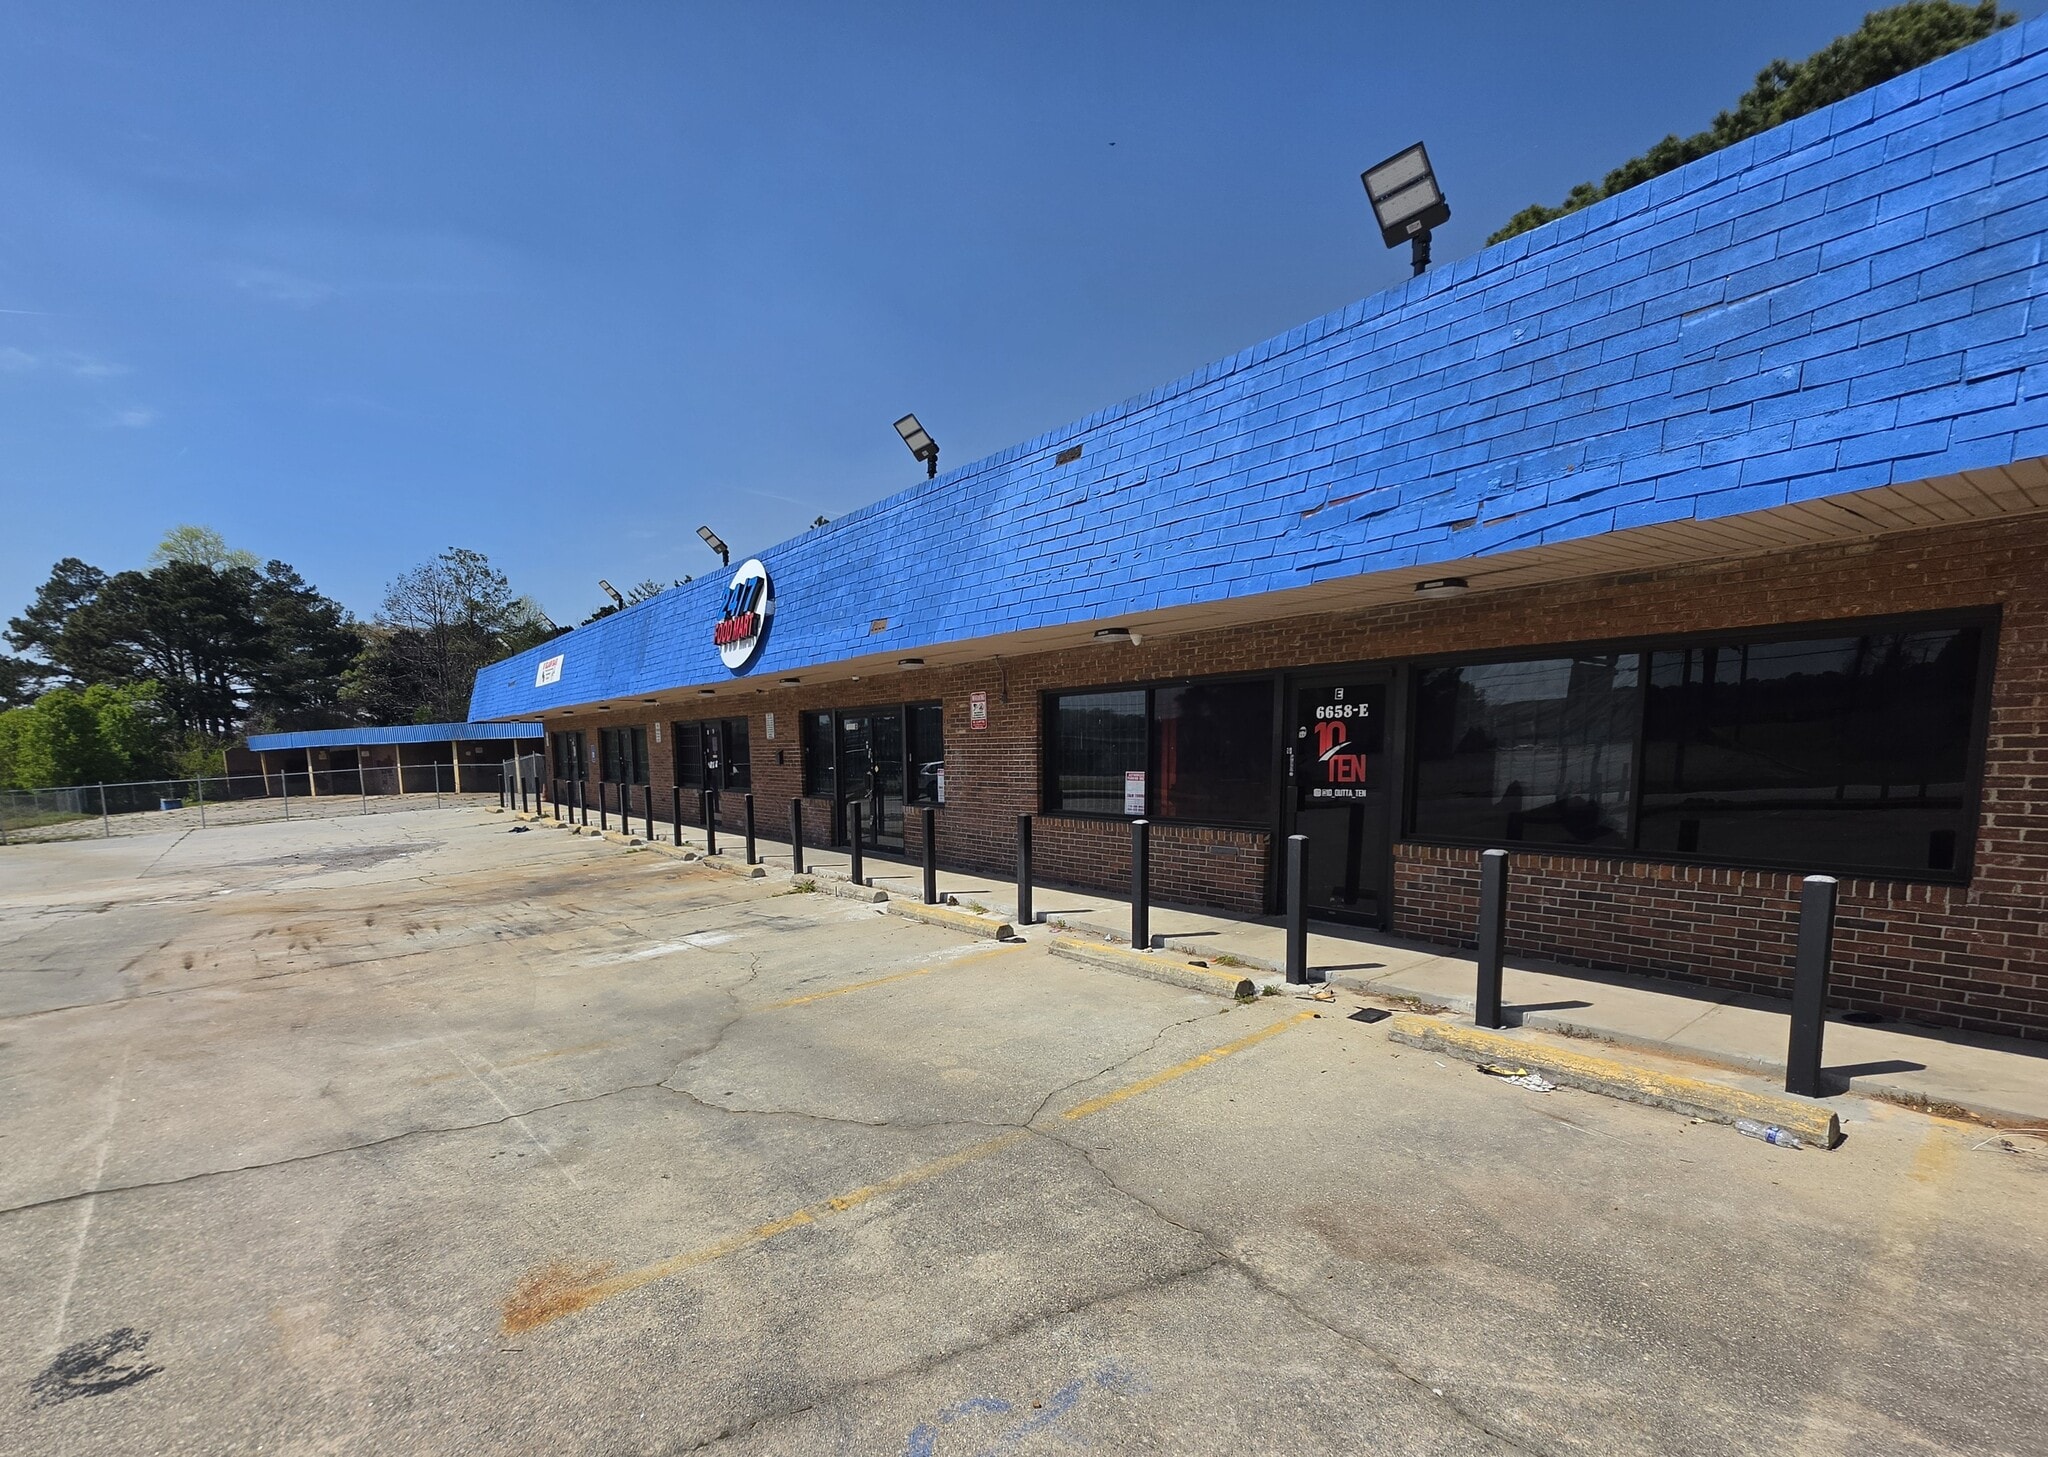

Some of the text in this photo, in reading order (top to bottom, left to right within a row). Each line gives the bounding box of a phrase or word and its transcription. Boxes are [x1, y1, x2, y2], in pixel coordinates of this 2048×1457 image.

[717, 576, 761, 620] 24/7
[714, 613, 755, 645] FOOD MART
[1334, 687, 1344, 700] E
[1316, 703, 1369, 719] 6658-E
[1314, 720, 1347, 757] 10
[1328, 754, 1367, 783] TEN
